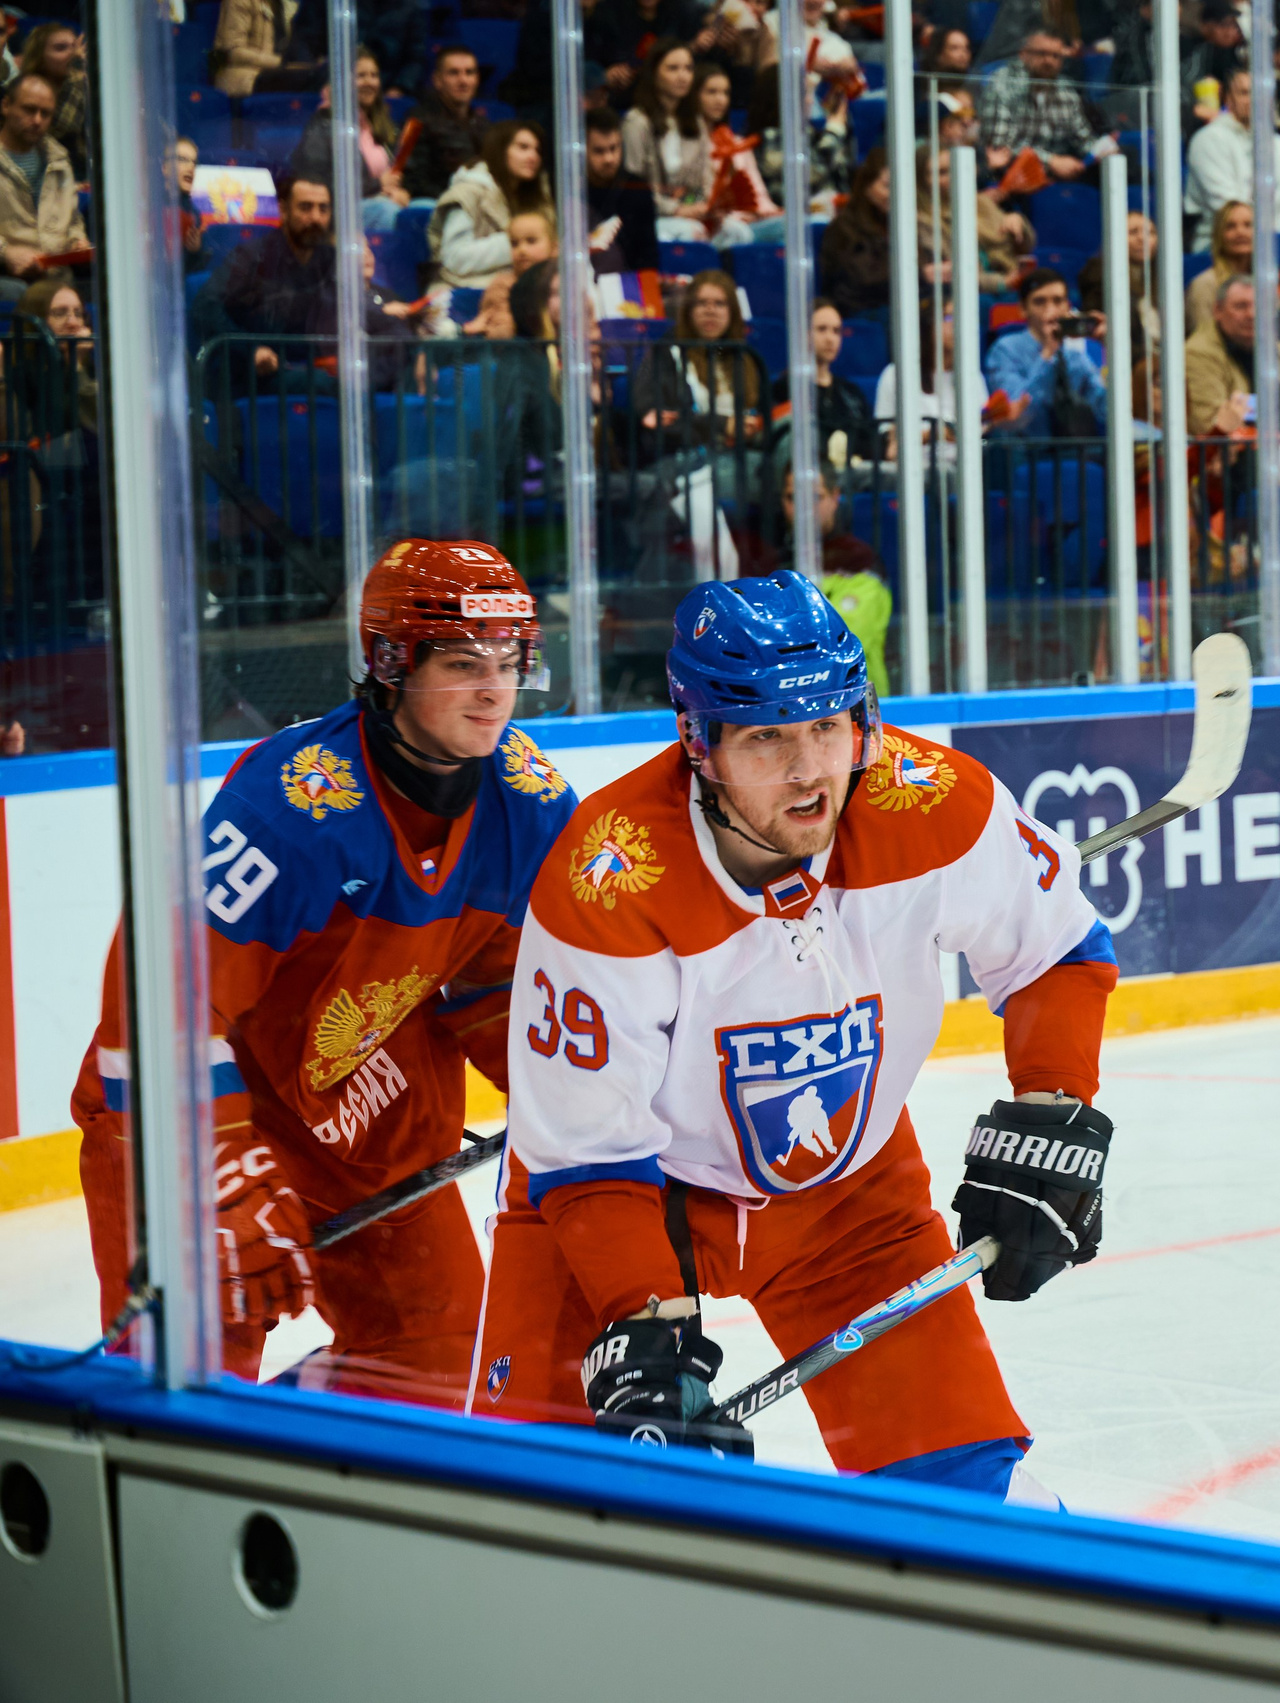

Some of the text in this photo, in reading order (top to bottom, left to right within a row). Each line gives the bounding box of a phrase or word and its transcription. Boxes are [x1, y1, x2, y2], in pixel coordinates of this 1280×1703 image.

[466, 599, 528, 614] РОЛЬФ
[778, 670, 831, 690] CCM
[201, 819, 280, 924] 29
[1014, 803, 1061, 892] 3
[526, 967, 610, 1072] 39
[729, 1006, 875, 1078] СХЛ
[303, 1046, 409, 1150] ОССИЯ
[1083, 1193, 1101, 1227] COVERT
